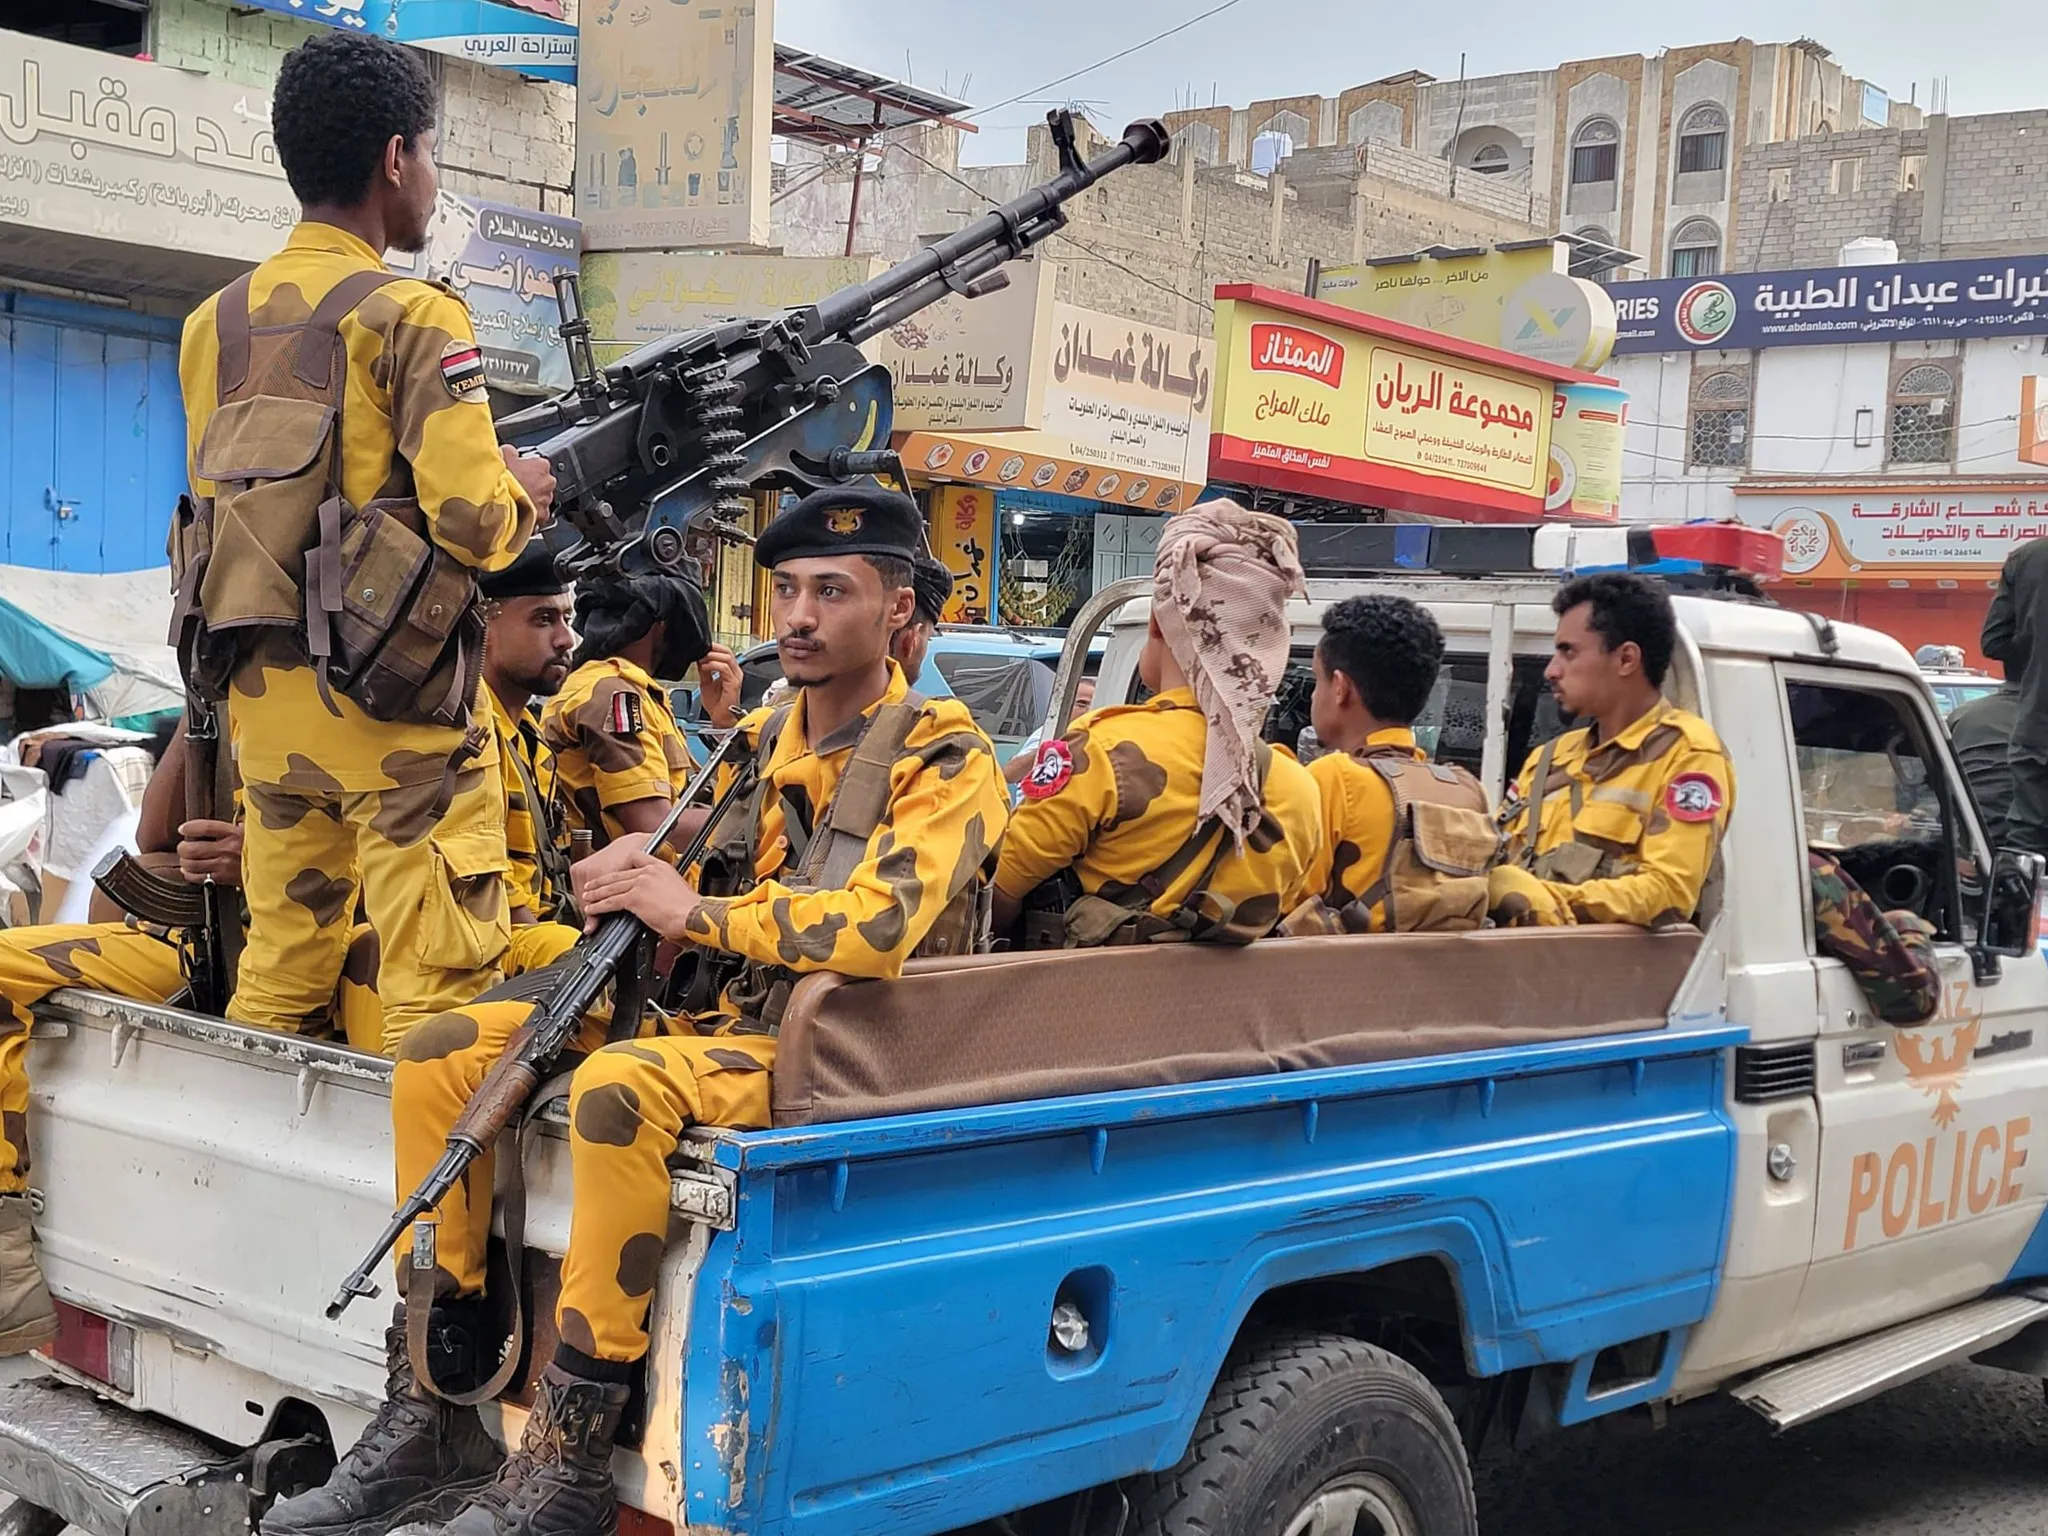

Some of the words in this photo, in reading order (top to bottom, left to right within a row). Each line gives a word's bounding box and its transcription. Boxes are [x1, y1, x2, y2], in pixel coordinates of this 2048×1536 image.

[464, 36, 516, 58] العربي
[541, 225, 575, 250] محلات
[1375, 278, 1398, 291] ناصر
[1470, 270, 1488, 282] من
[1754, 277, 1858, 319] الطبية
[1866, 275, 1959, 313] عبدان
[1761, 319, 1858, 334] www.abdanlab.com
[1053, 321, 1136, 384] غمدان
[1260, 332, 1335, 376] الممتاز
[955, 351, 1013, 394] وكالة
[1140, 332, 1208, 413] وكالة
[1376, 362, 1443, 415] الريان
[1255, 389, 1300, 421] المزاج
[1298, 401, 1331, 426] ملك
[1449, 381, 1533, 439] مجموعة
[1852, 498, 1940, 521] الشارقة
[1945, 498, 2021, 521] شعاع
[1881, 524, 1969, 542] والتحويلات
[1843, 1116, 2031, 1251] POLICE
